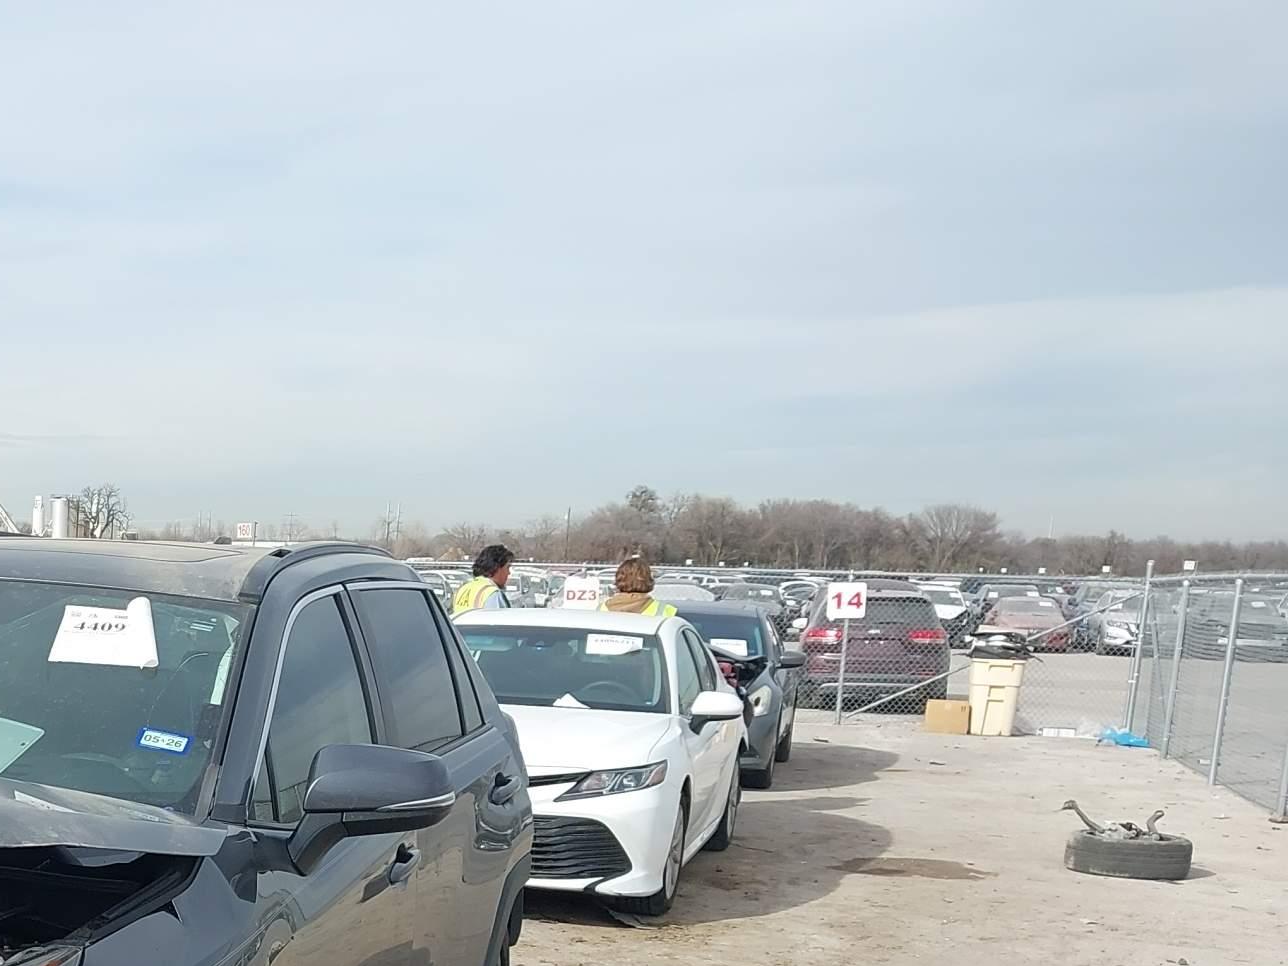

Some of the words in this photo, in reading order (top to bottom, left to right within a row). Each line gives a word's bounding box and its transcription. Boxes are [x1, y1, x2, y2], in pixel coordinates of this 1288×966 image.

[566, 590, 597, 601] DZ3
[832, 591, 863, 609] 14
[73, 621, 126, 632] 4409
